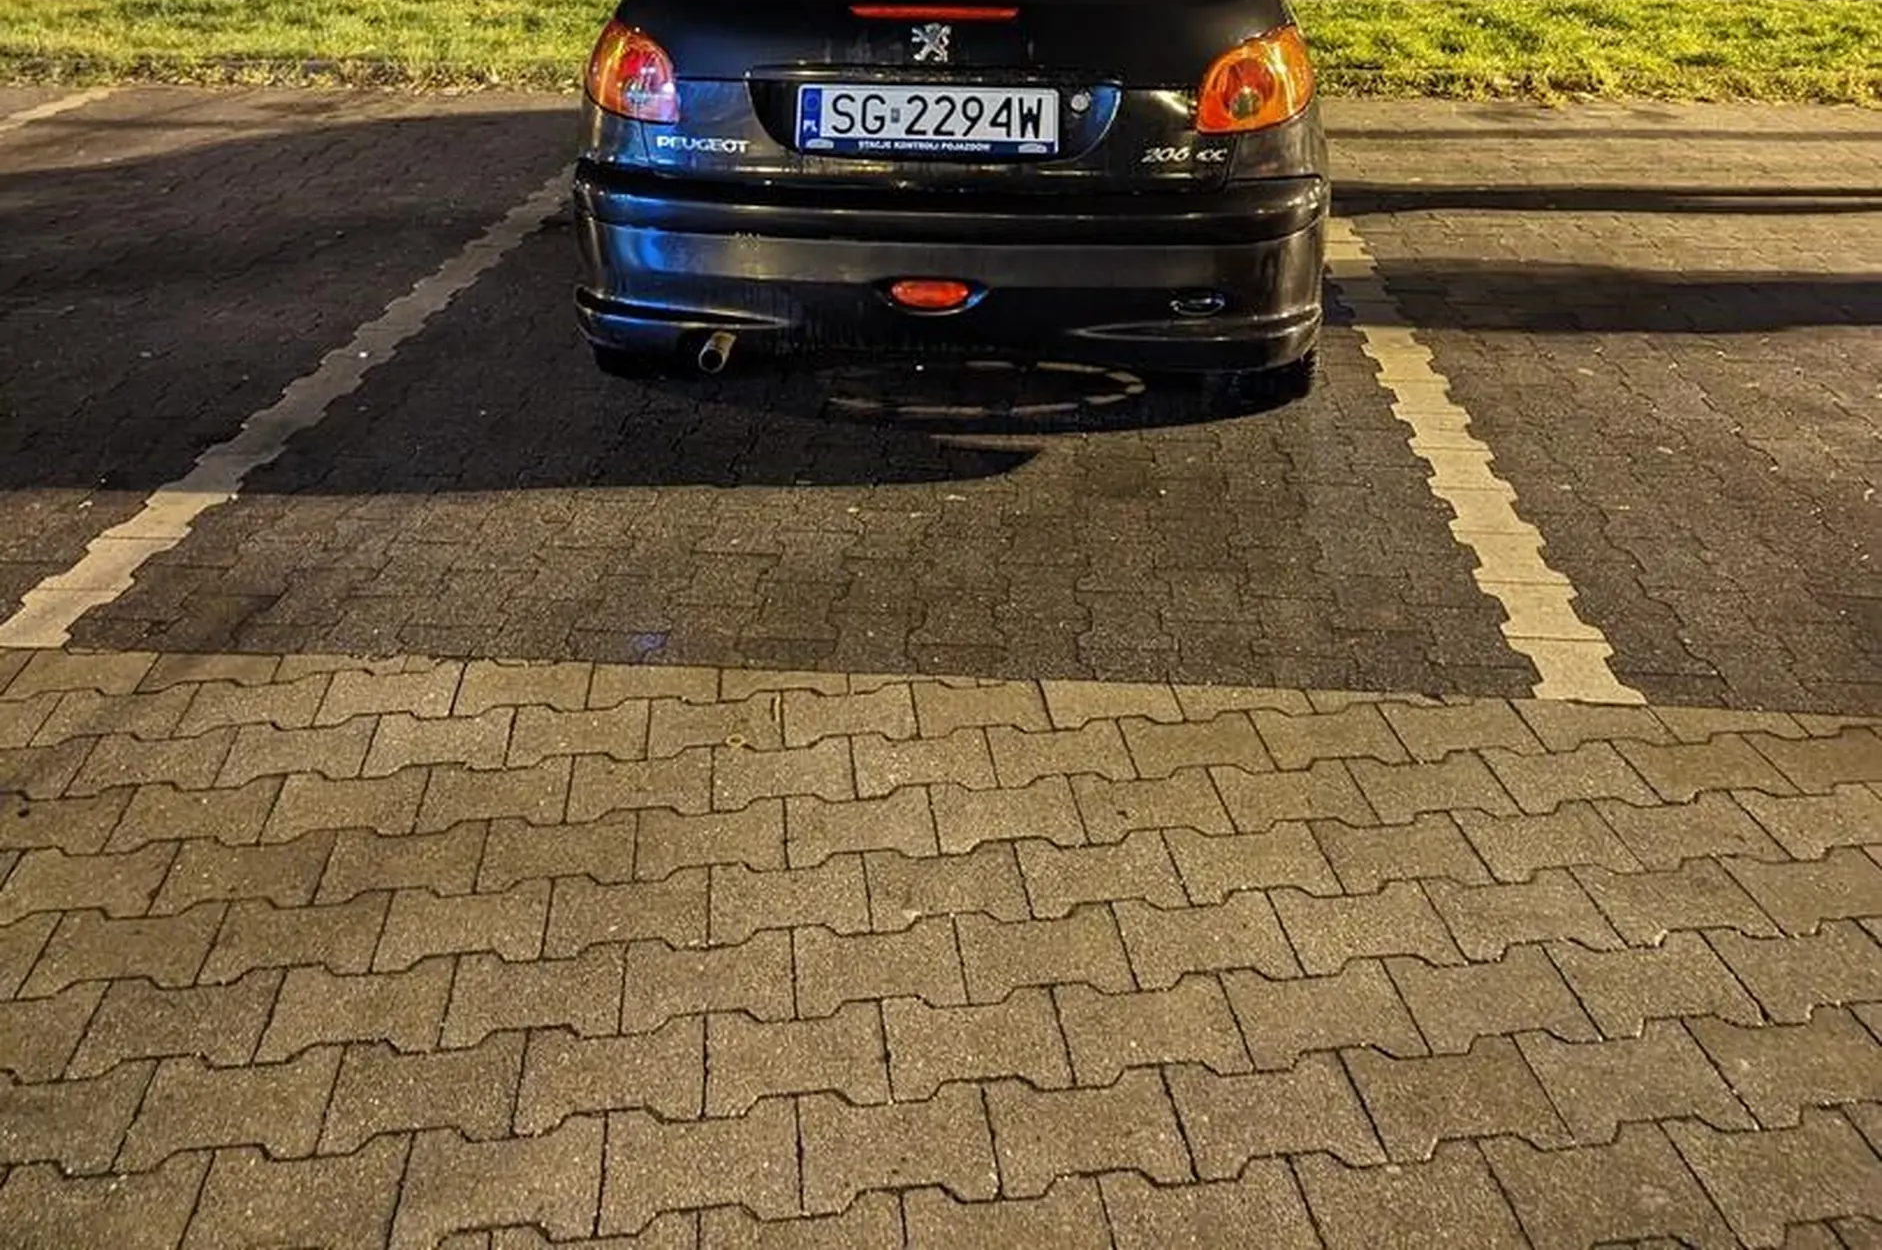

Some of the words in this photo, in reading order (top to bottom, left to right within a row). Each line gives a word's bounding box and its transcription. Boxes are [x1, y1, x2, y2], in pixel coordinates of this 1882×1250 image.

[831, 94, 886, 135] SG
[904, 95, 1042, 138] 2294W
[803, 120, 817, 132] PL
[656, 136, 750, 154] PEUGEOT
[1141, 147, 1190, 162] 206
